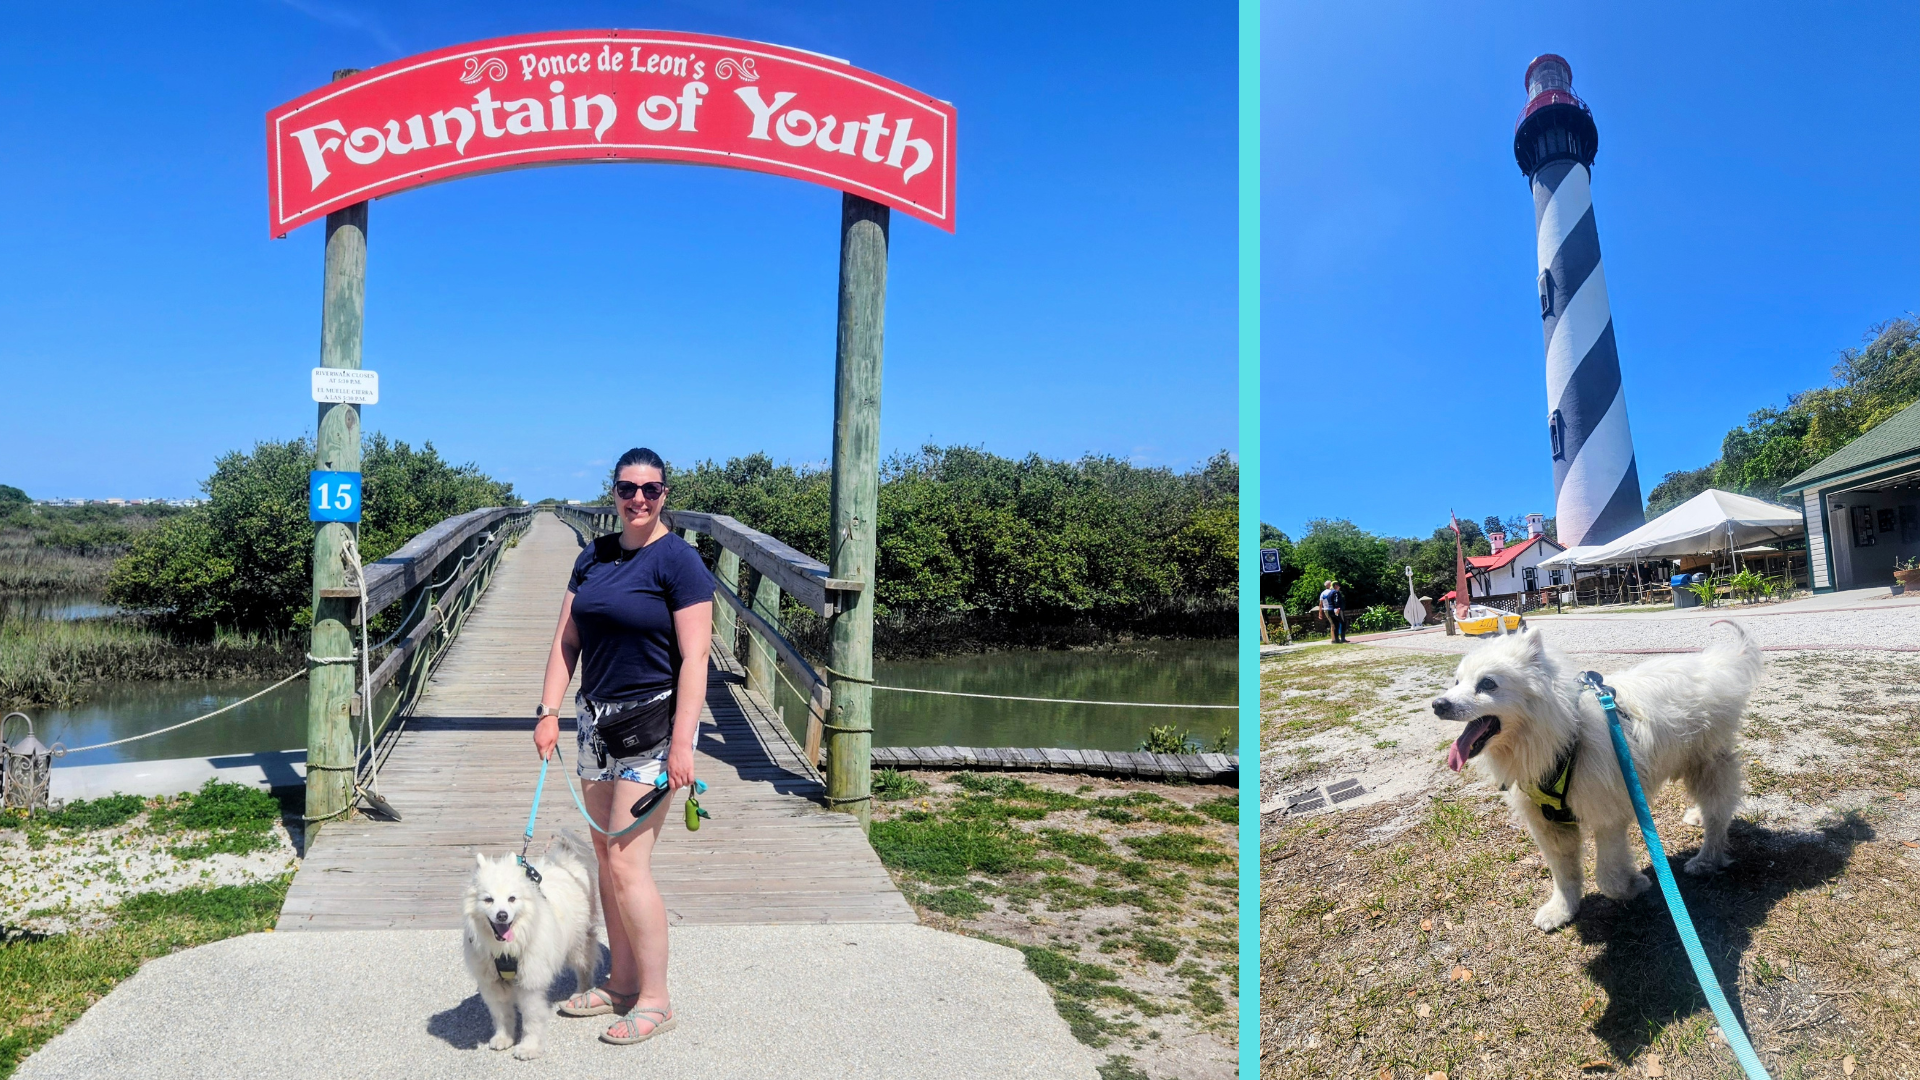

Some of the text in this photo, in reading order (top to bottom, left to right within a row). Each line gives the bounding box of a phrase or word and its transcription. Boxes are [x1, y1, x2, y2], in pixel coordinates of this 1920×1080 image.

[519, 45, 706, 82] Ponce de Leon's
[289, 80, 934, 192] Fountain of Youth
[317, 482, 352, 510] 15
